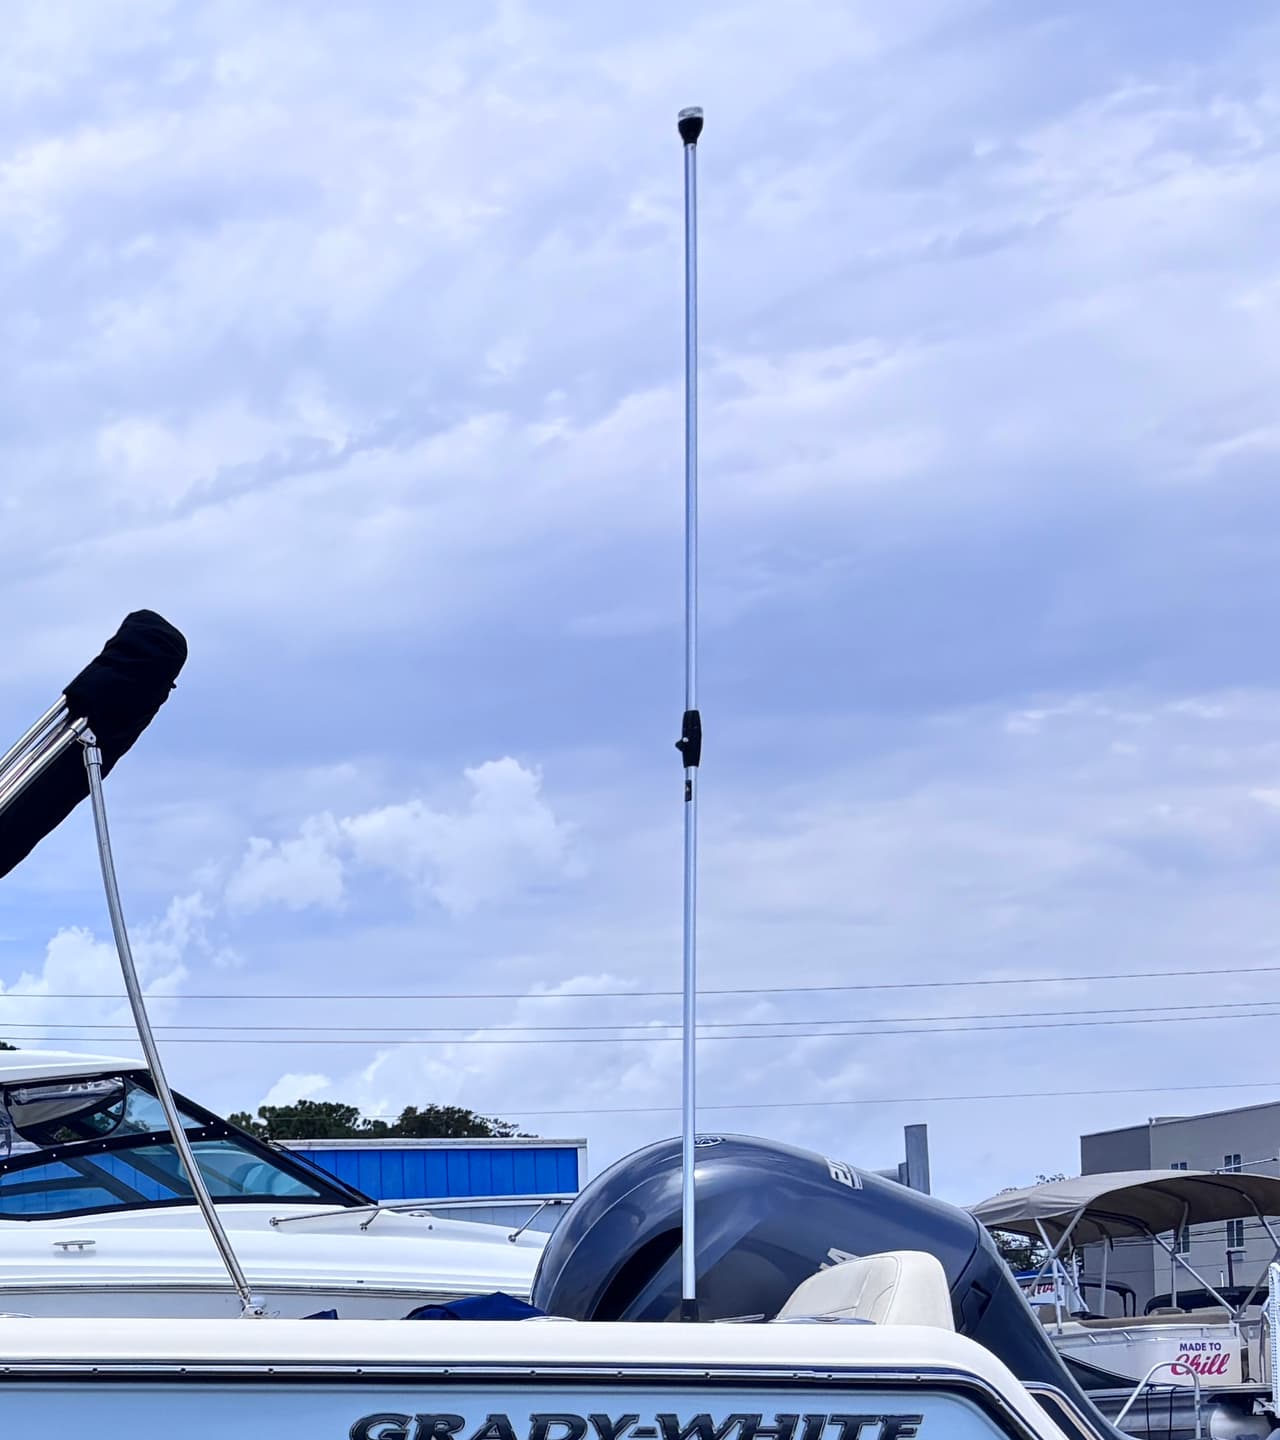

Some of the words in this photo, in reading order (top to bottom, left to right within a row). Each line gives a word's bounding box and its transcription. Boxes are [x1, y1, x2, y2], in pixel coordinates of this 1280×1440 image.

[1179, 1342, 1207, 1351] MADE
[1209, 1342, 1222, 1351] TO
[1171, 1353, 1230, 1375] Chill
